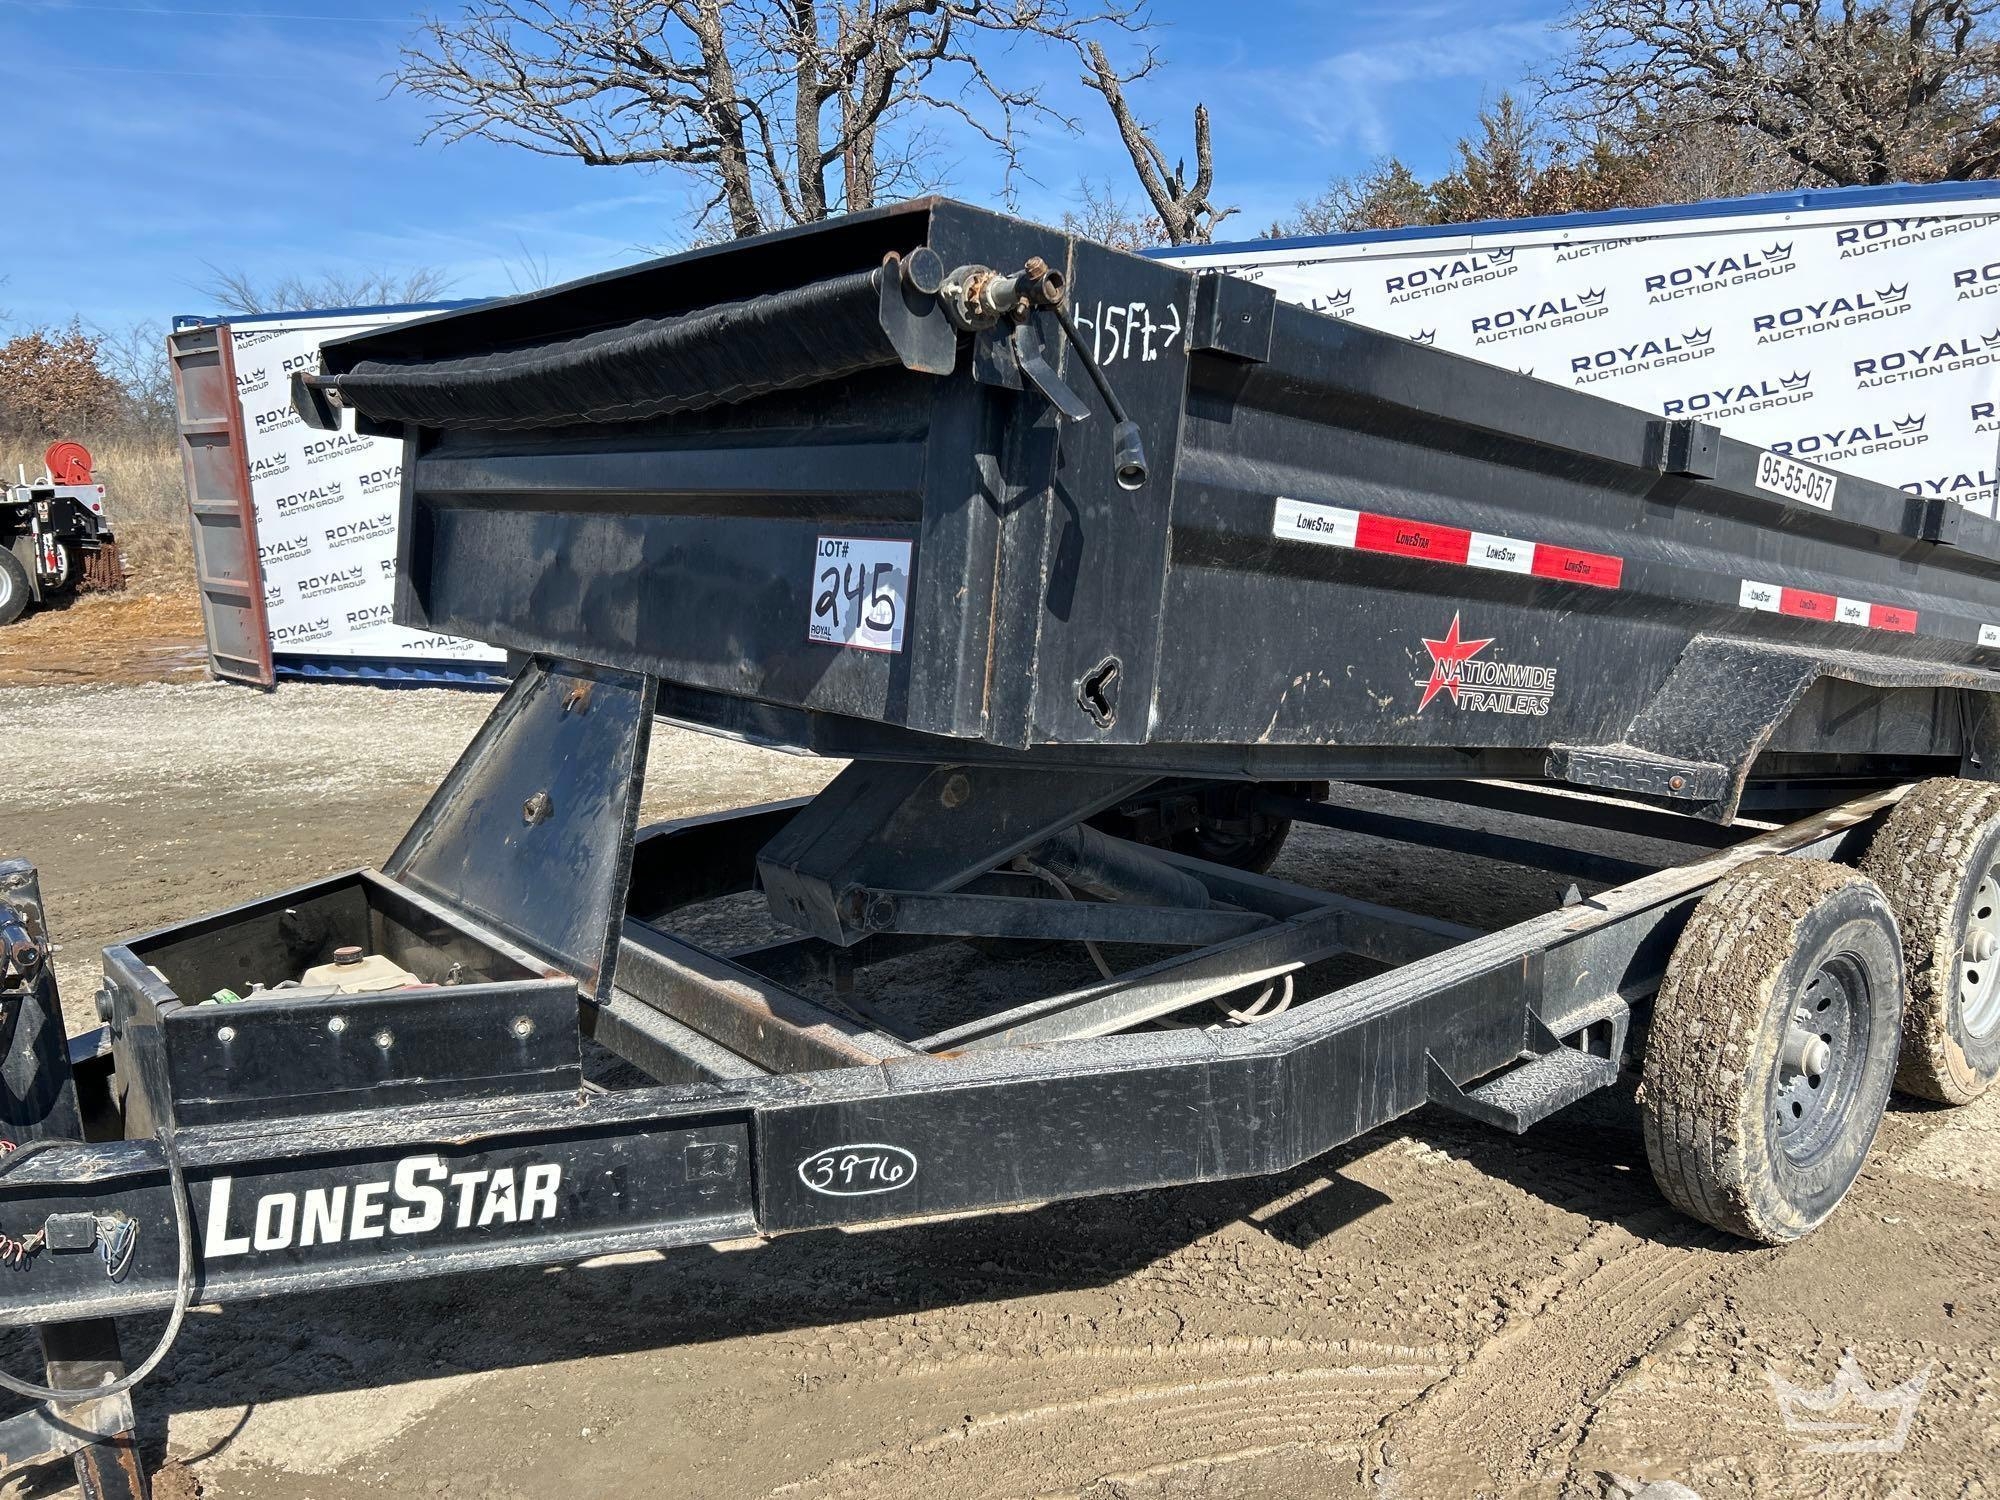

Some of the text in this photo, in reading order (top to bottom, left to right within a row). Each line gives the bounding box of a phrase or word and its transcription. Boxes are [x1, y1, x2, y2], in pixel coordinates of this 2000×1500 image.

[1840, 214, 2000, 260] AUCTION GROUP
[1556, 236, 1632, 264] AUCTION
[1385, 256, 1488, 293] ROYAL
[1390, 265, 1518, 305] AUCTION GROUP
[1645, 253, 1762, 293] ROYAL
[1649, 262, 1796, 305] AUCTION GROUP
[1471, 297, 1578, 334] ROYAL
[1753, 293, 1875, 333] ROYAL
[1757, 303, 1912, 345] AUCTION GROUP
[1475, 307, 1609, 346] AUCTION GROUP
[237, 337, 273, 351] AUCTION
[1571, 337, 1682, 373] ROYAL
[1575, 347, 1715, 385] AUCTION GROUP
[1854, 339, 1981, 377] ROYAL
[242, 381, 269, 395] GROUP
[1857, 364, 1944, 390] AUCTION
[1663, 381, 1779, 416] ROYAL
[1749, 391, 1814, 412] GROUP
[256, 404, 297, 426] ROYA
[259, 420, 294, 434] AUCTION
[304, 433, 357, 457] ROYAL
[1771, 424, 1893, 456] ROYAL
[1862, 434, 1929, 455] GROUP
[307, 441, 375, 465] AUCTION GROUP
[263, 465, 290, 479] GROUP
[359, 466, 403, 487] ROYA
[1762, 456, 1833, 504] 95-55-057
[276, 487, 328, 509] ROYAL
[280, 494, 345, 518] AUCTION GROUP
[325, 518, 379, 541] ROYAL
[329, 526, 396, 549] AUCTION GROUP
[284, 548, 311, 561] GROUP
[818, 540, 849, 558] LOT#
[298, 570, 349, 592] ROYAL
[301, 578, 366, 600] AUCTION GROUP
[815, 562, 896, 632] 245
[346, 604, 392, 623] ROYA
[350, 619, 387, 632] AUCTION
[306, 630, 333, 644] GROUP
[811, 625, 831, 637] ROYAL
[1436, 657, 1557, 690] NATIONWIDE
[1459, 690, 1551, 716] TRAILERS
[811, 1155, 904, 1188] 3976
